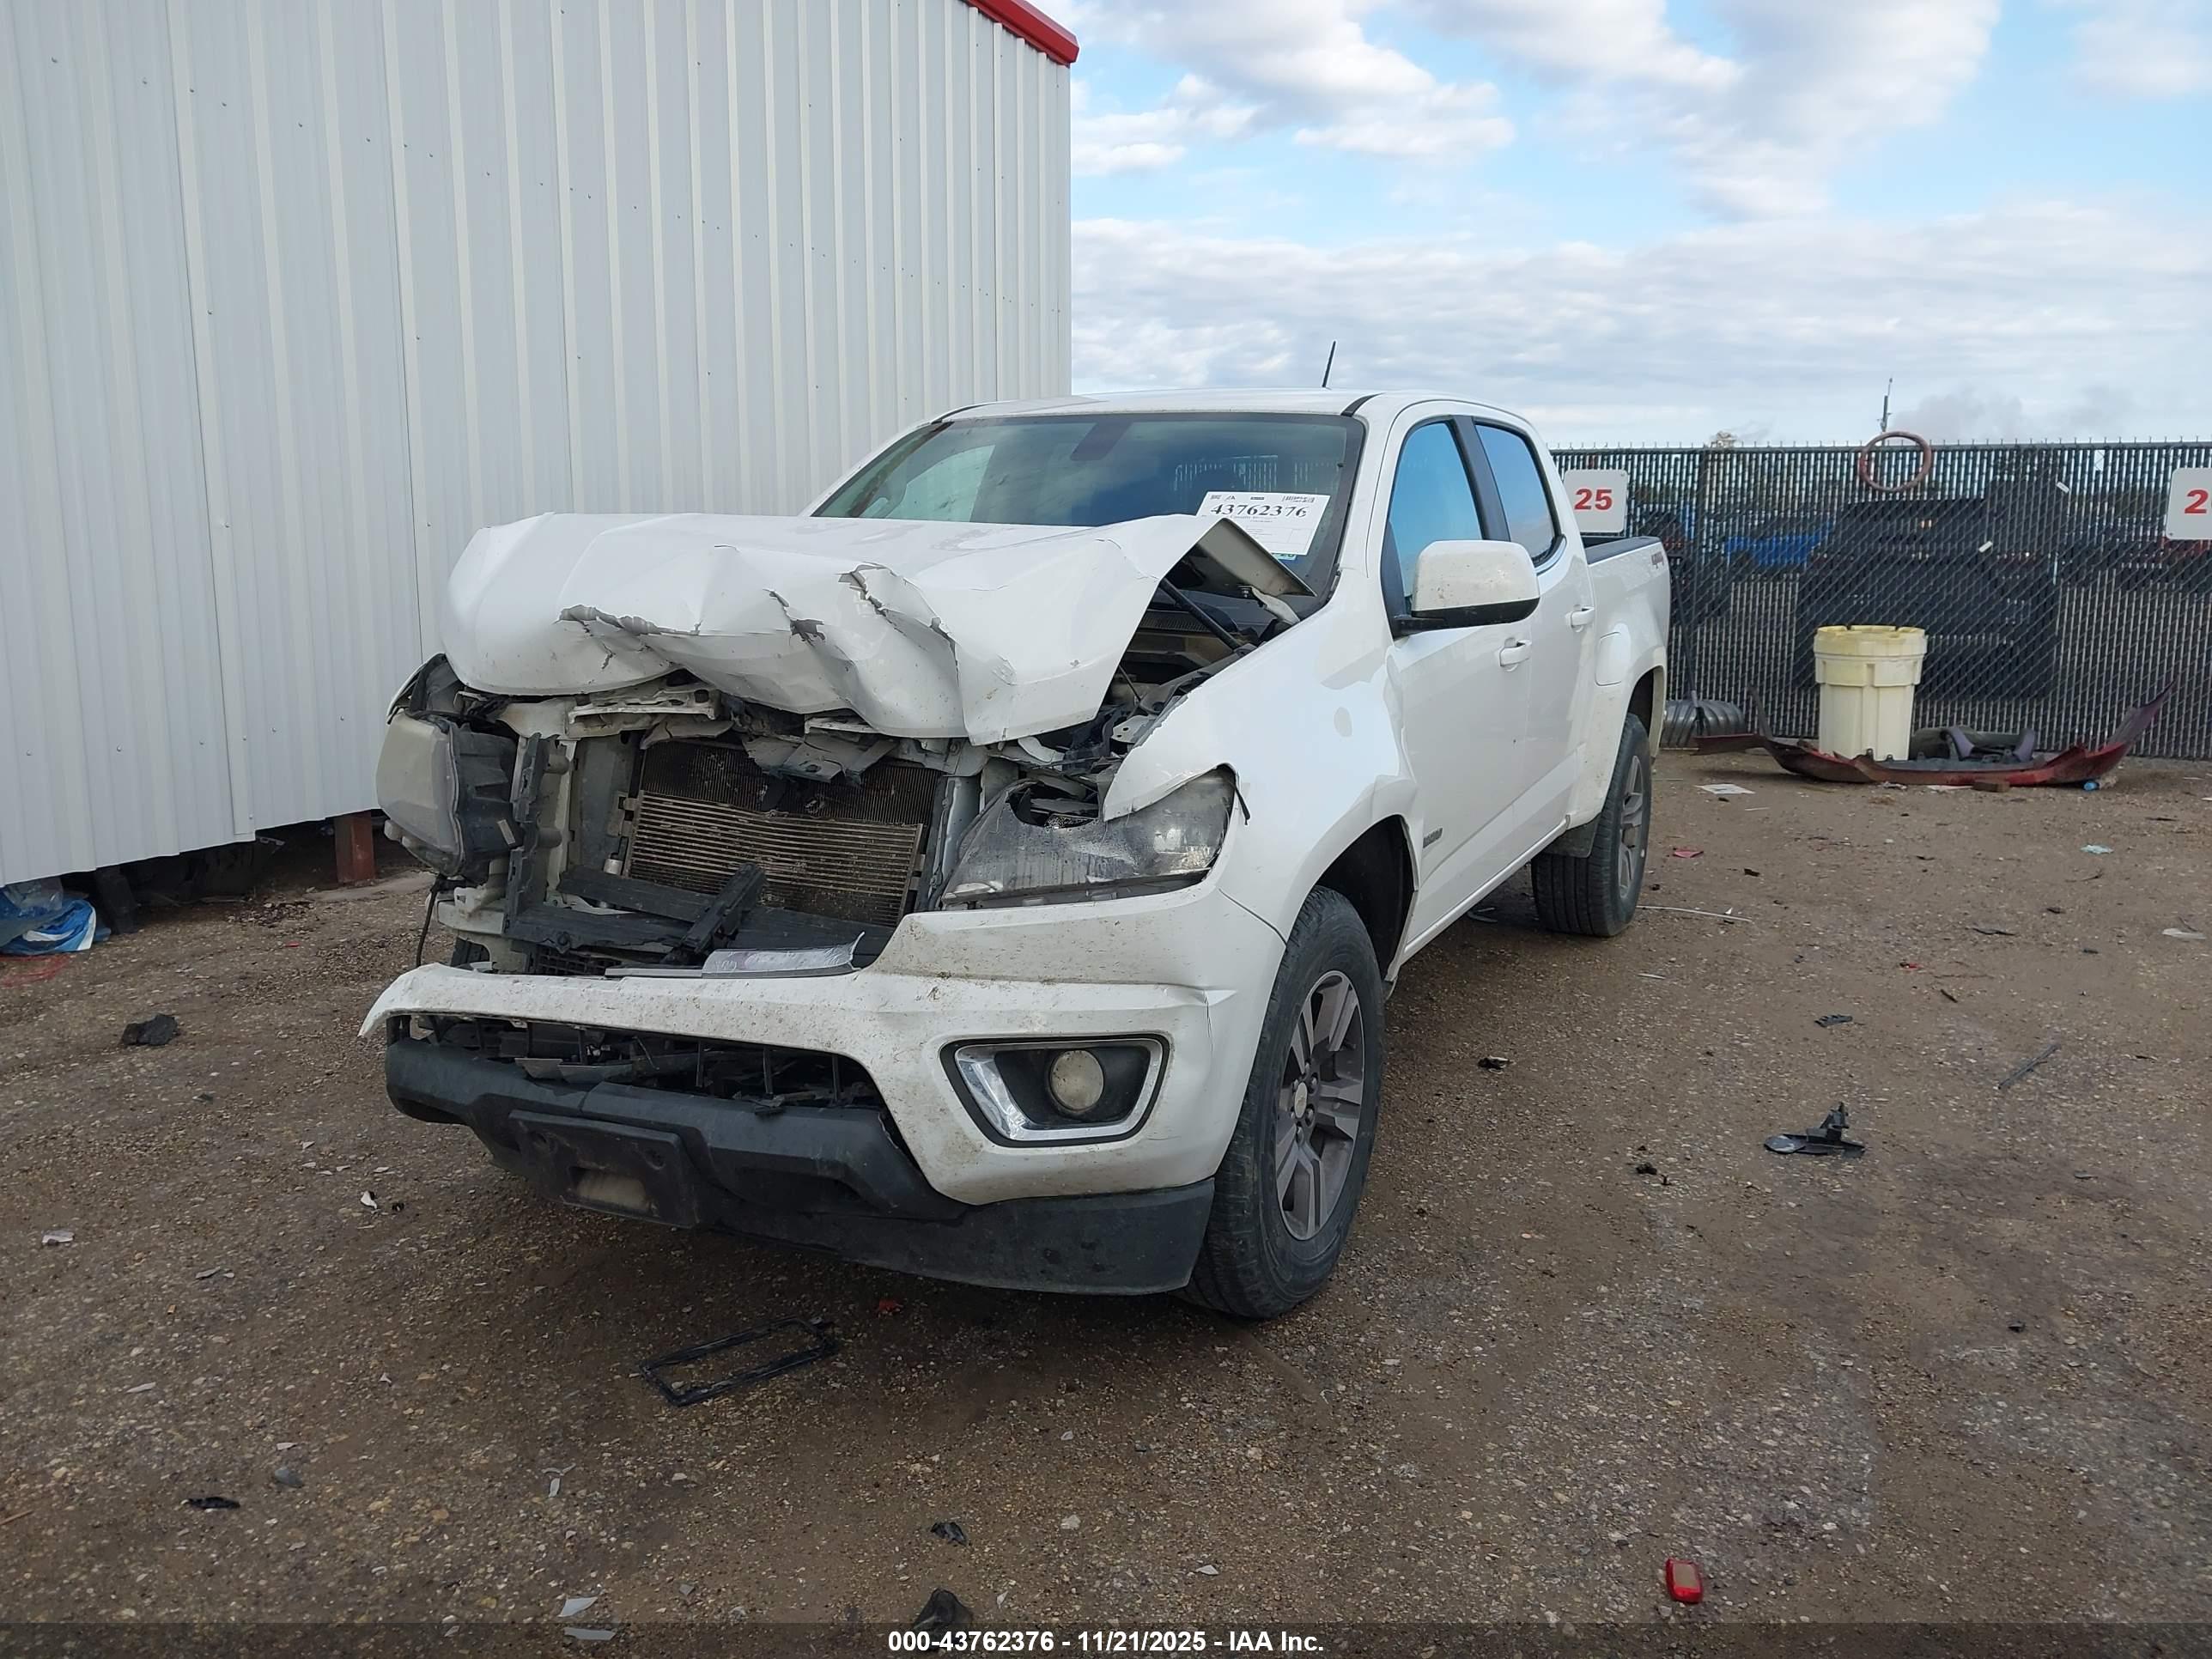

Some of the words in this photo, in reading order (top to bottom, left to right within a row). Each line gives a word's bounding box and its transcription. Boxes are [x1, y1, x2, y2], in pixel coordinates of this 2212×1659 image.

[1574, 489, 1613, 510] 25
[2184, 489, 2212, 514] 2
[1211, 504, 1307, 518] 43762376
